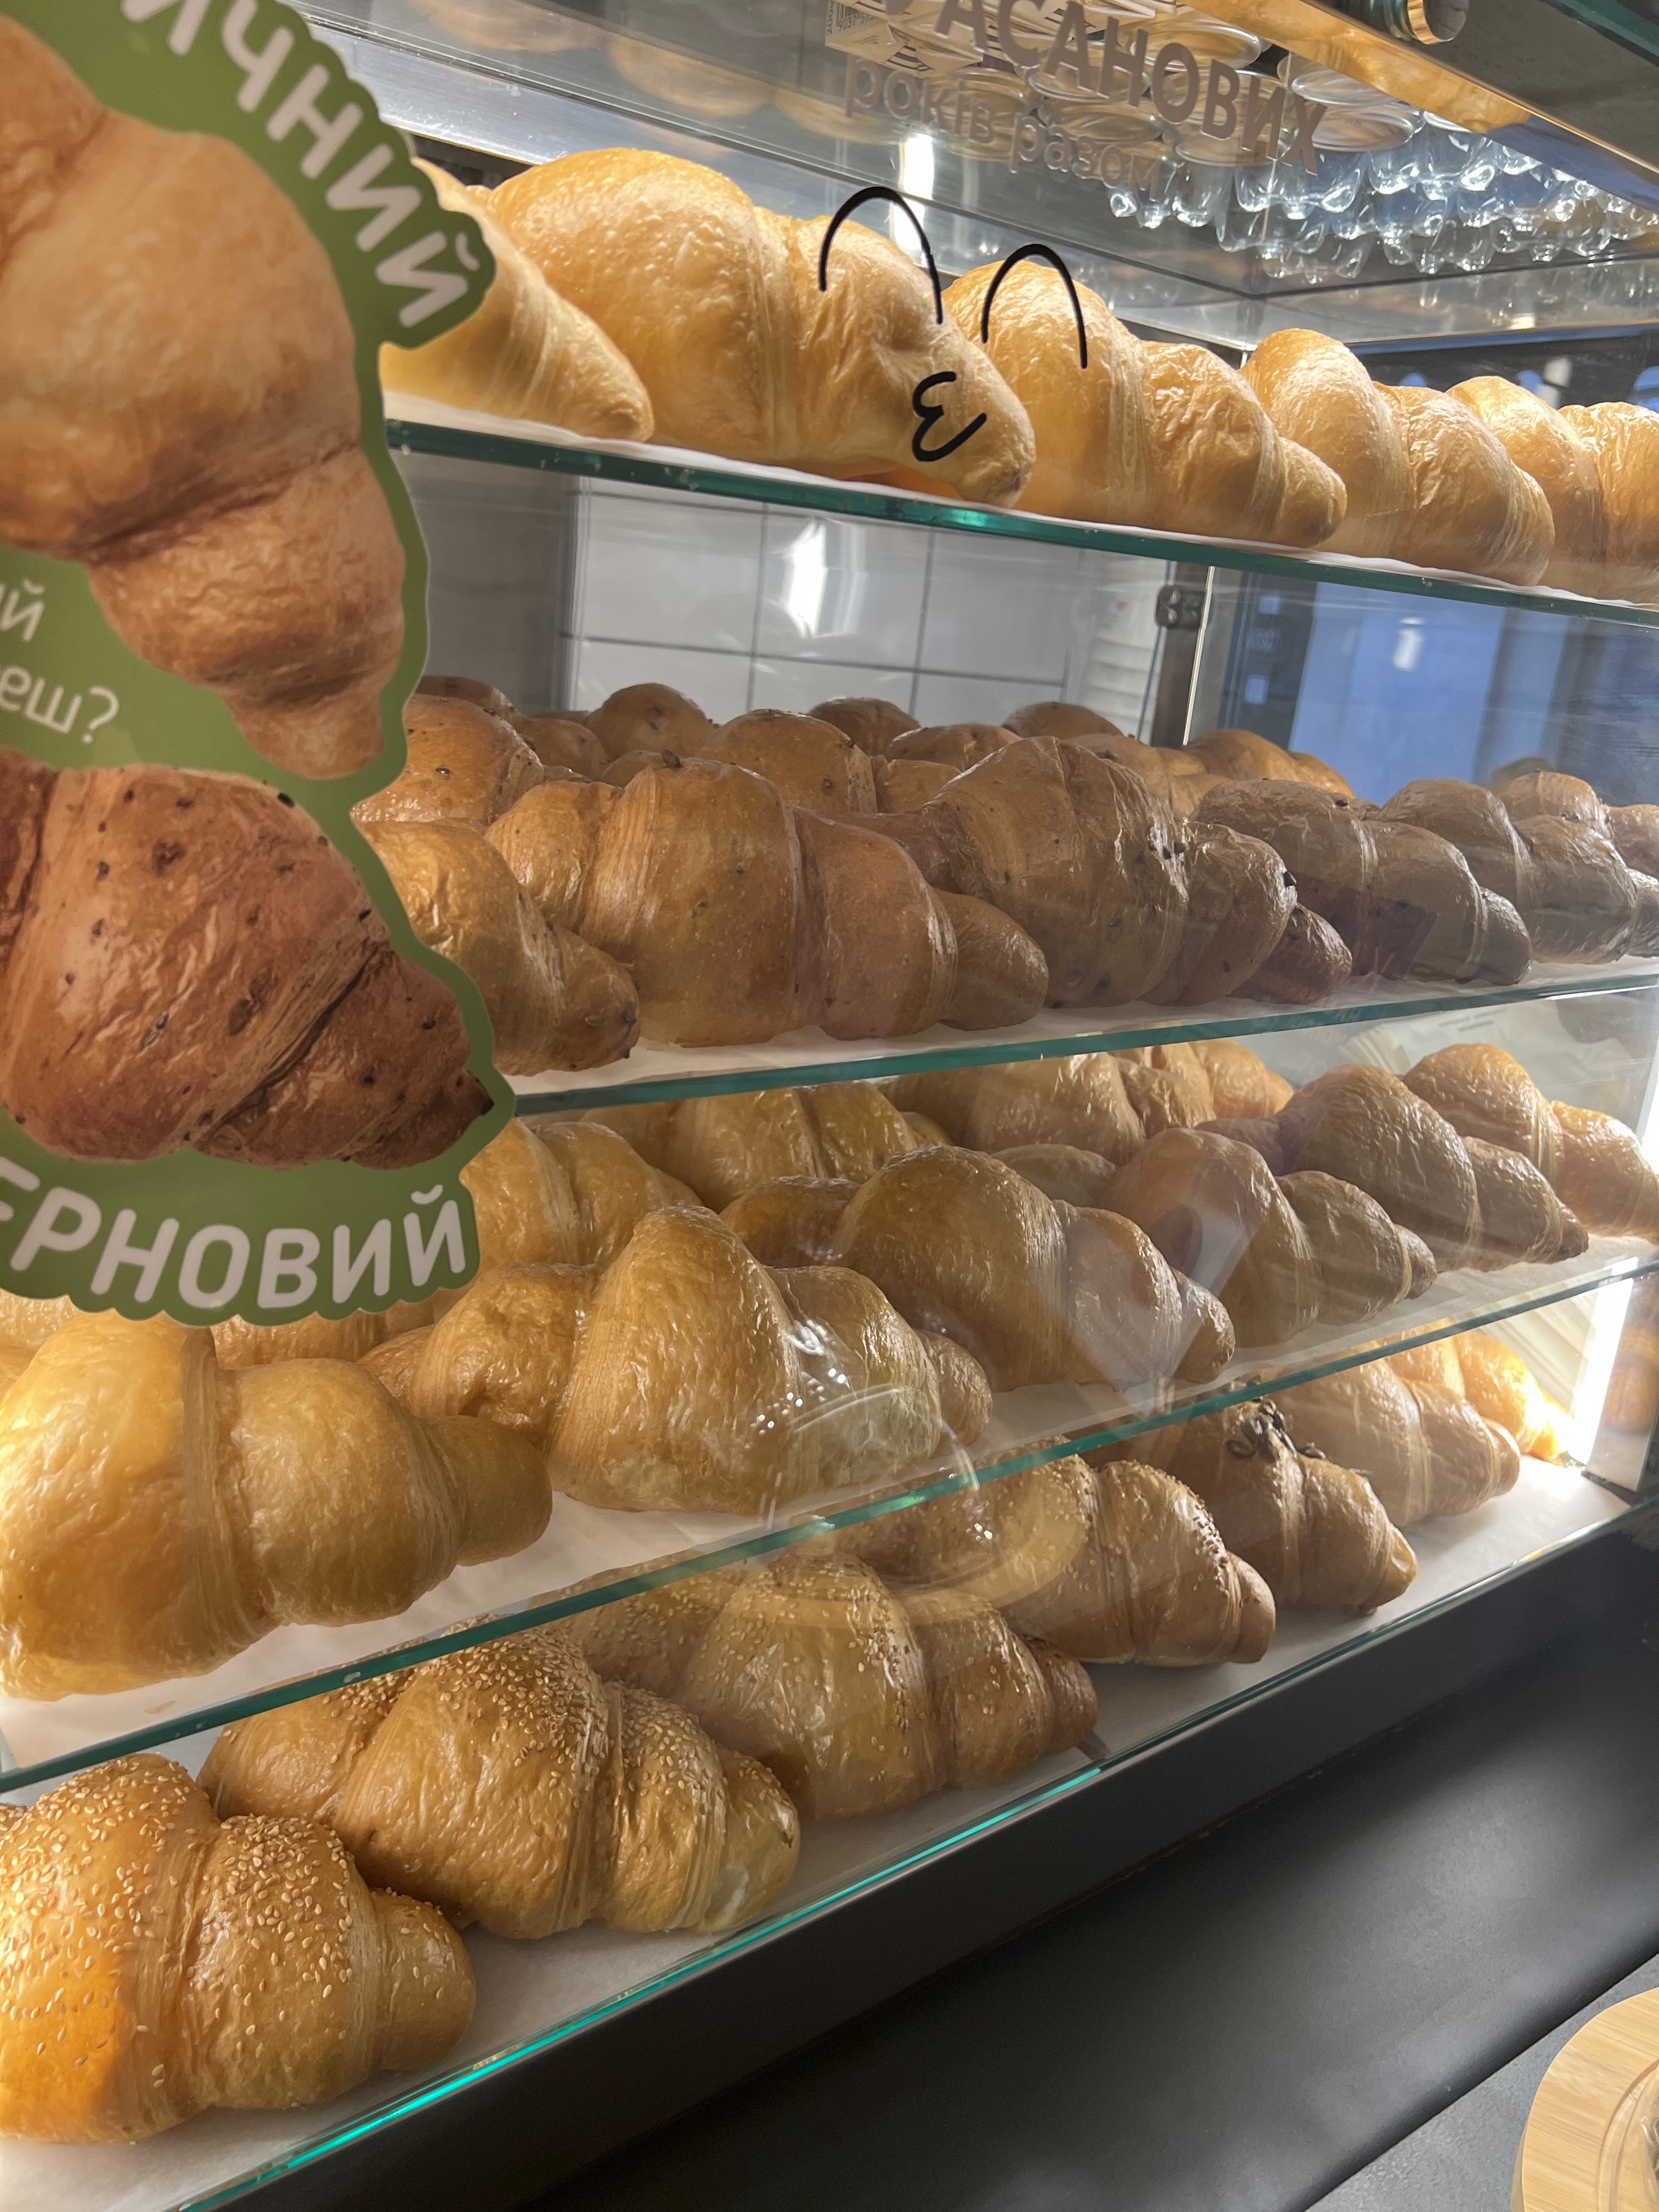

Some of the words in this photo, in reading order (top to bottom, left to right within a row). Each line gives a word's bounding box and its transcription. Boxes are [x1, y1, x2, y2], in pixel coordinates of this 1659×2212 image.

[845, 55, 997, 144] років
[1009, 112, 1161, 202] разом
[887, 0, 1327, 175] АСАНОВИХ
[0, 579, 45, 642] й
